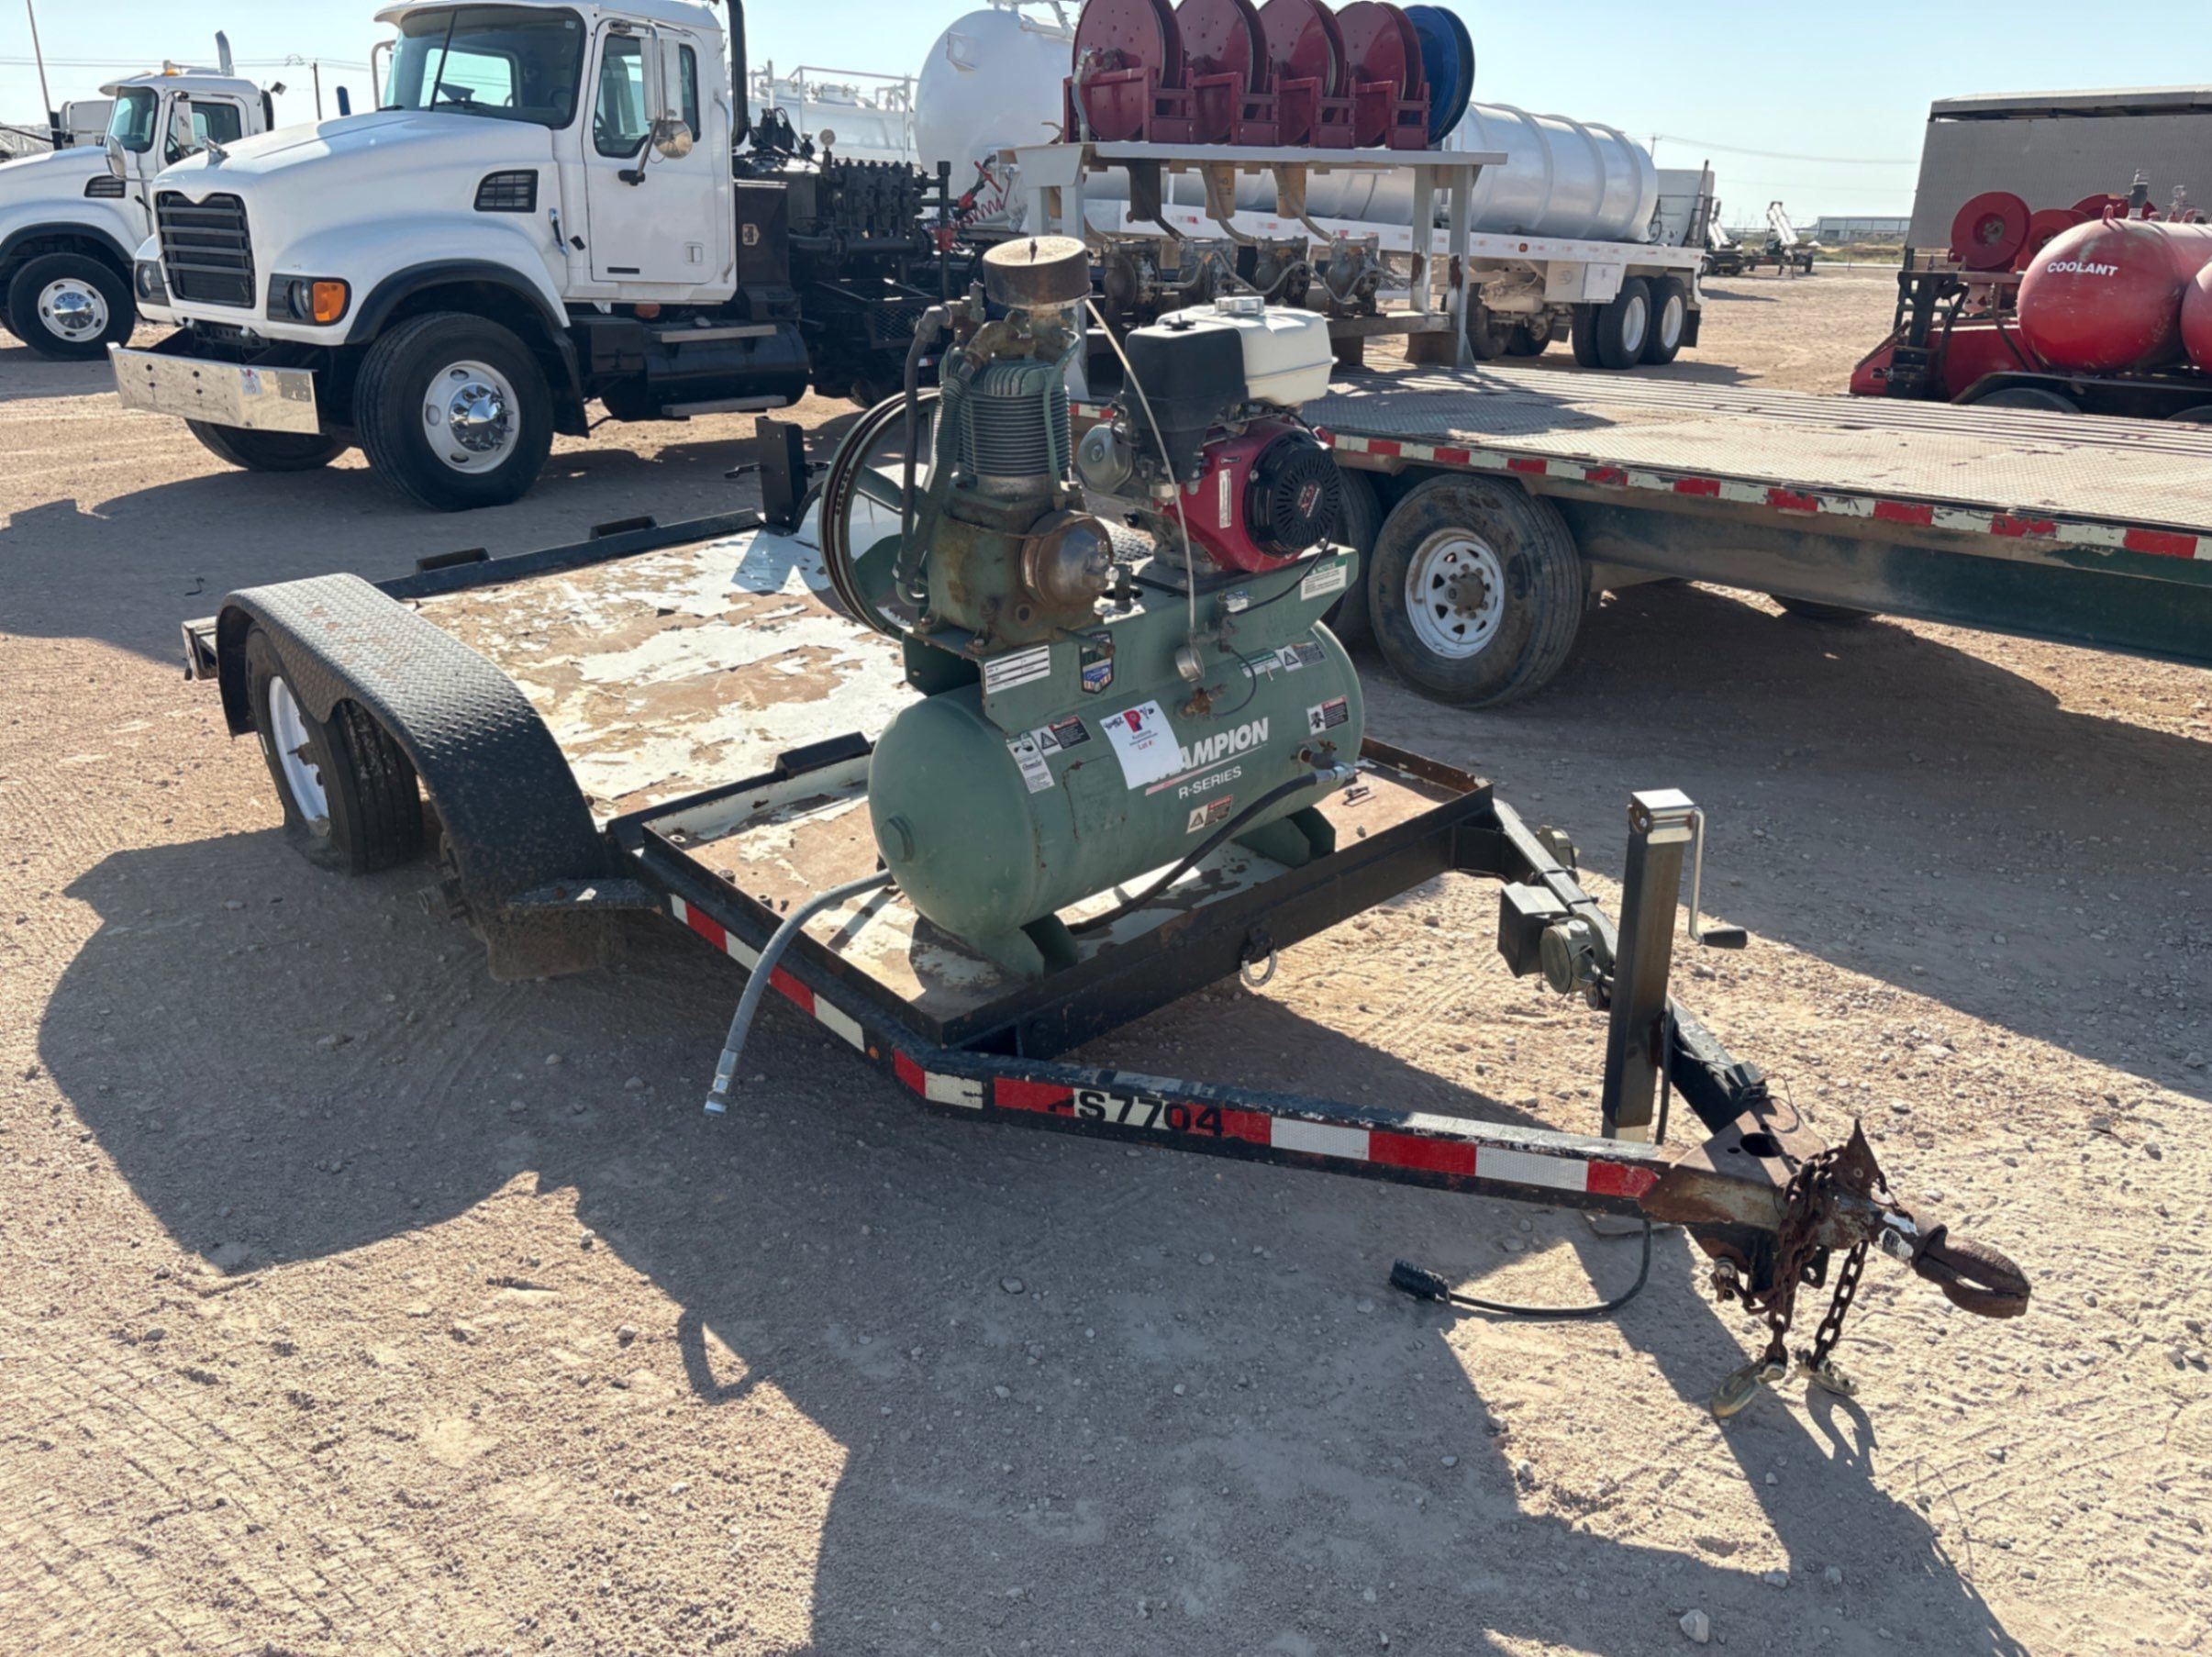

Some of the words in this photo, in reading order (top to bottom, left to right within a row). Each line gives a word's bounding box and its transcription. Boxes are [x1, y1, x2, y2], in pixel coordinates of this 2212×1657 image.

[2047, 261, 2118, 276] COOLANT
[1179, 717, 1268, 770] AMPION
[1178, 765, 1242, 799] R-SERIES
[1078, 1090, 1224, 1137] S7704
